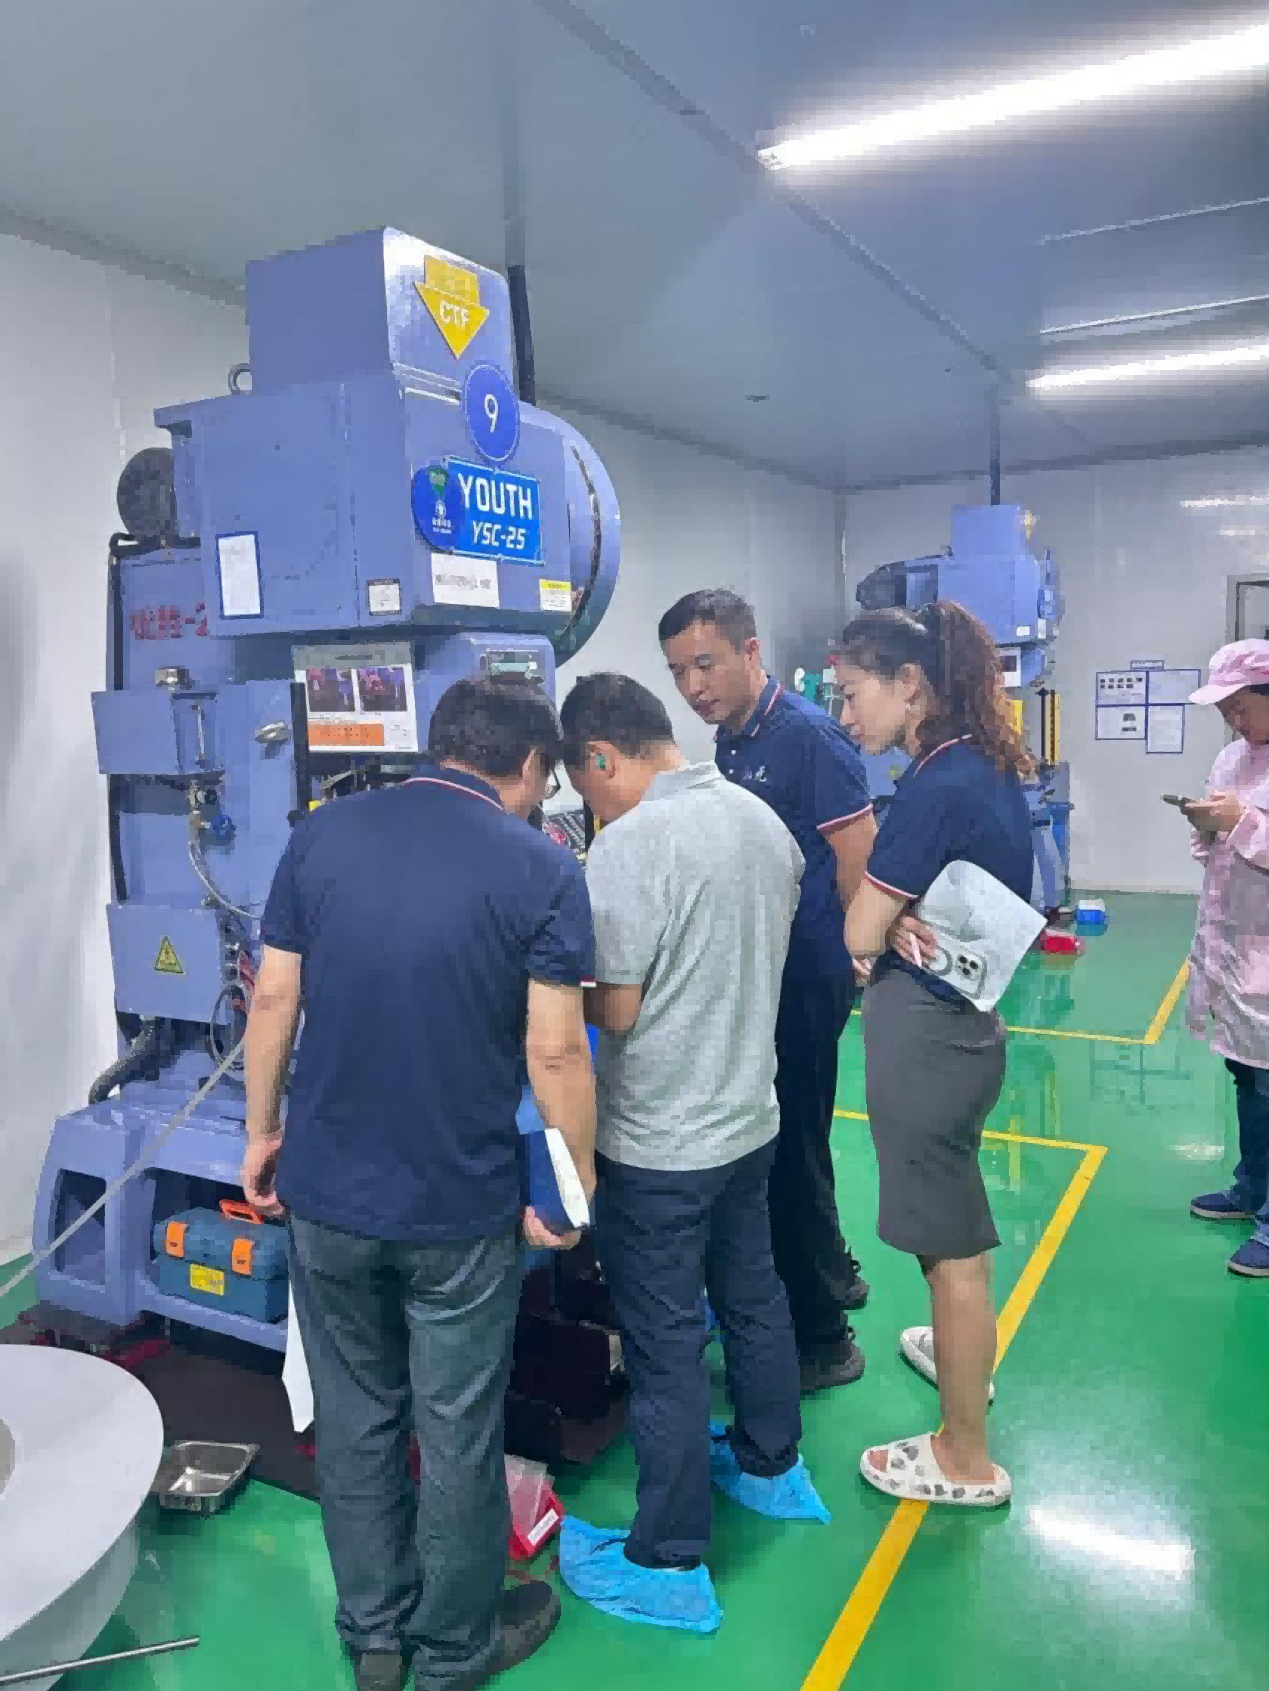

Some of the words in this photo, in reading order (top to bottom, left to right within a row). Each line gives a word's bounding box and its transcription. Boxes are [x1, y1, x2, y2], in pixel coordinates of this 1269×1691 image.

[440, 300, 471, 327] CTF
[484, 394, 498, 433] 9
[457, 472, 532, 520] YOUTH
[473, 520, 526, 550] YSC-25
